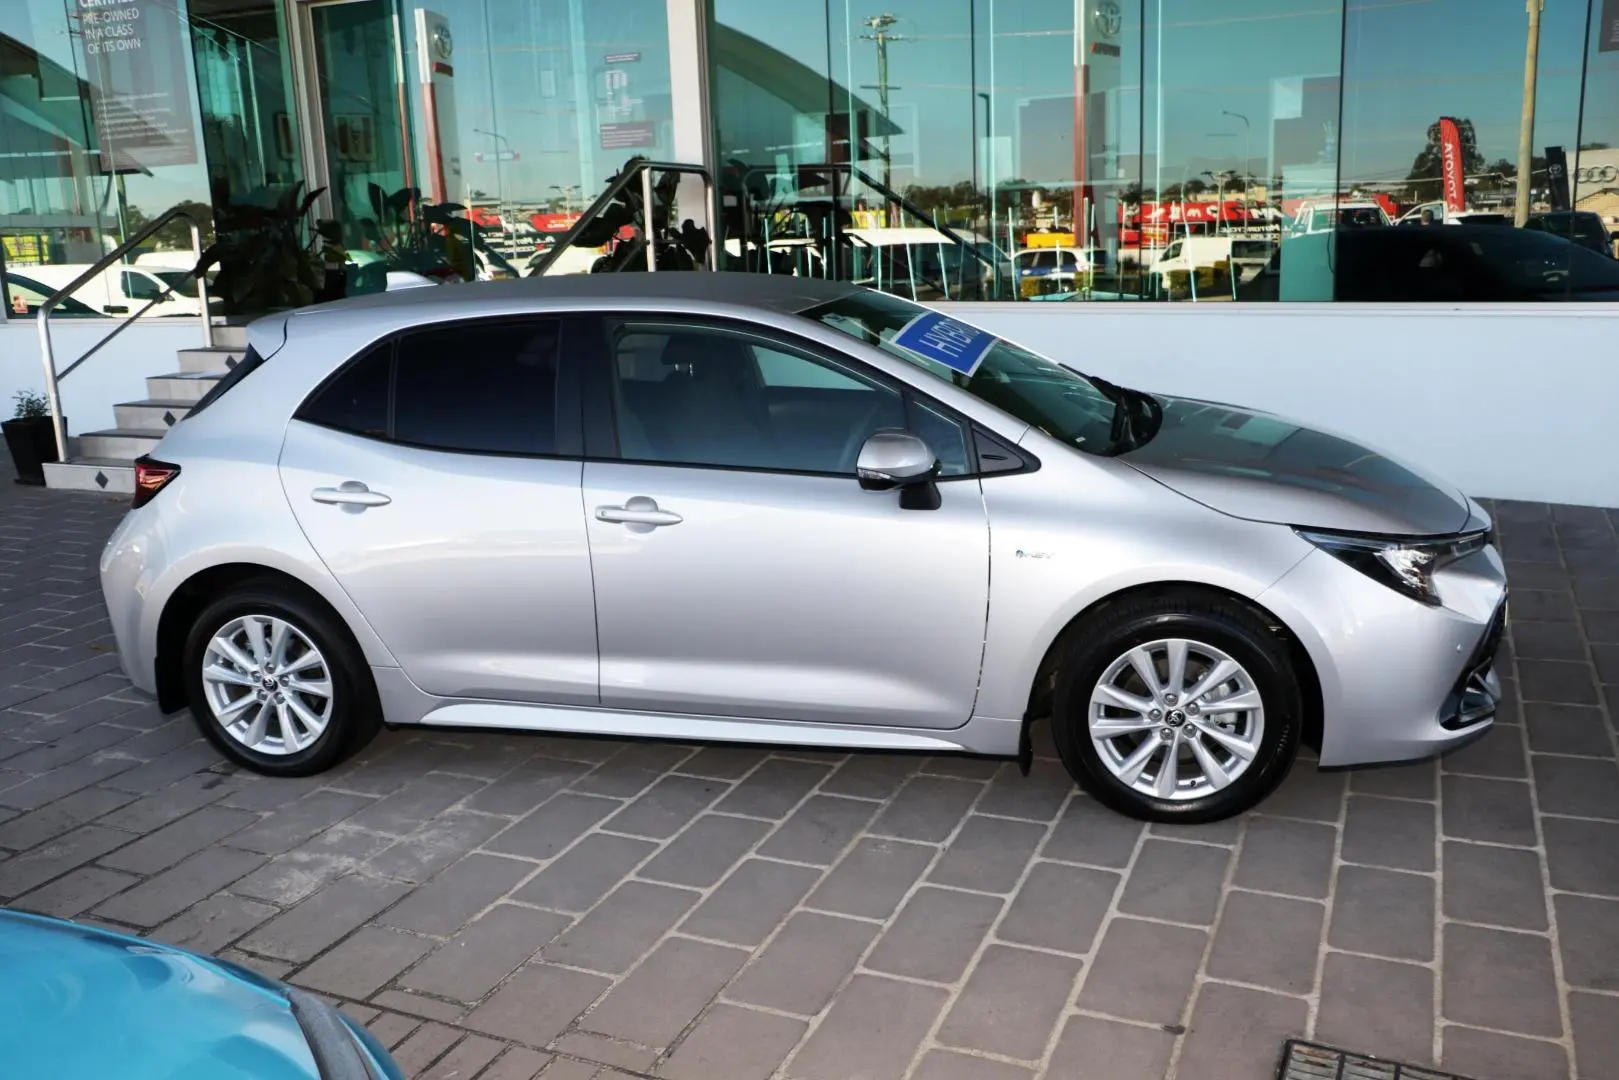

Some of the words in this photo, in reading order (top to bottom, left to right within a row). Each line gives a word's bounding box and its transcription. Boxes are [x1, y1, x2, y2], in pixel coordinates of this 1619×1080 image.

[82, 7, 140, 25] PRE-OWNED
[85, 29, 96, 40] IN
[97, 28, 104, 39] A
[104, 23, 134, 38] CLASS
[87, 43, 100, 54] OF
[102, 41, 116, 53] ITS
[116, 38, 142, 51] OWN
[918, 317, 981, 358] HYBR
